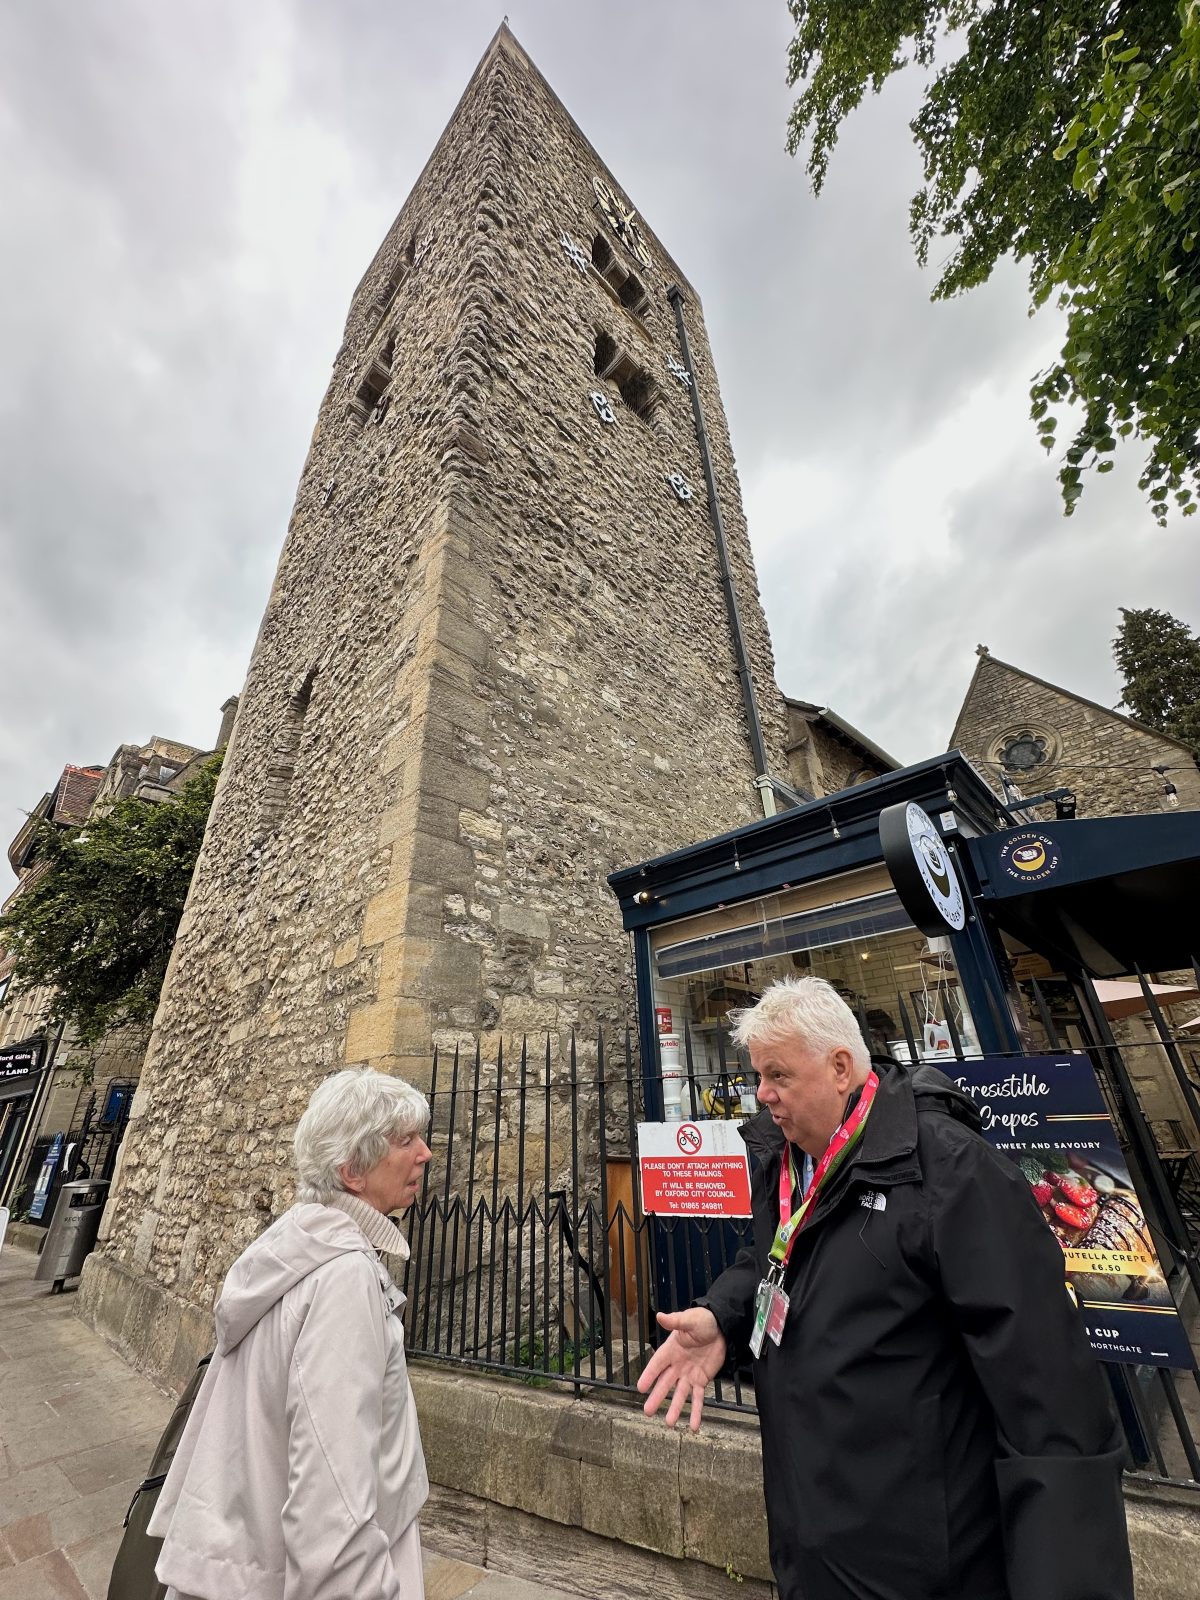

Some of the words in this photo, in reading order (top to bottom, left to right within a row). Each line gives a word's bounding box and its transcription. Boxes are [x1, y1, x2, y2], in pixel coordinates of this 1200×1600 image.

[1001, 845, 1009, 857] THE
[1008, 833, 1037, 845] GOLDEN
[1039, 836, 1053, 845] CUP
[1006, 867, 1019, 878] THE
[1020, 869, 1051, 881] GOLDEN
[1050, 856, 1059, 869] CUP
[6, 1068, 29, 1076] LAND
[979, 1105, 1039, 1137] Crepes
[996, 1142, 1026, 1150] SWEET
[1054, 1141, 1101, 1149] SAVOURY
[695, 1182, 726, 1190] REMOVED
[691, 1190, 705, 1198] CITY
[707, 1190, 736, 1198] COUNCIL
[701, 1202, 723, 1210] 249811
[1112, 1254, 1147, 1263] CREPE
[1091, 1263, 1121, 1272] £6.50
[1094, 1327, 1120, 1339] CUP
[1090, 1342, 1143, 1354] NORTHGATE
